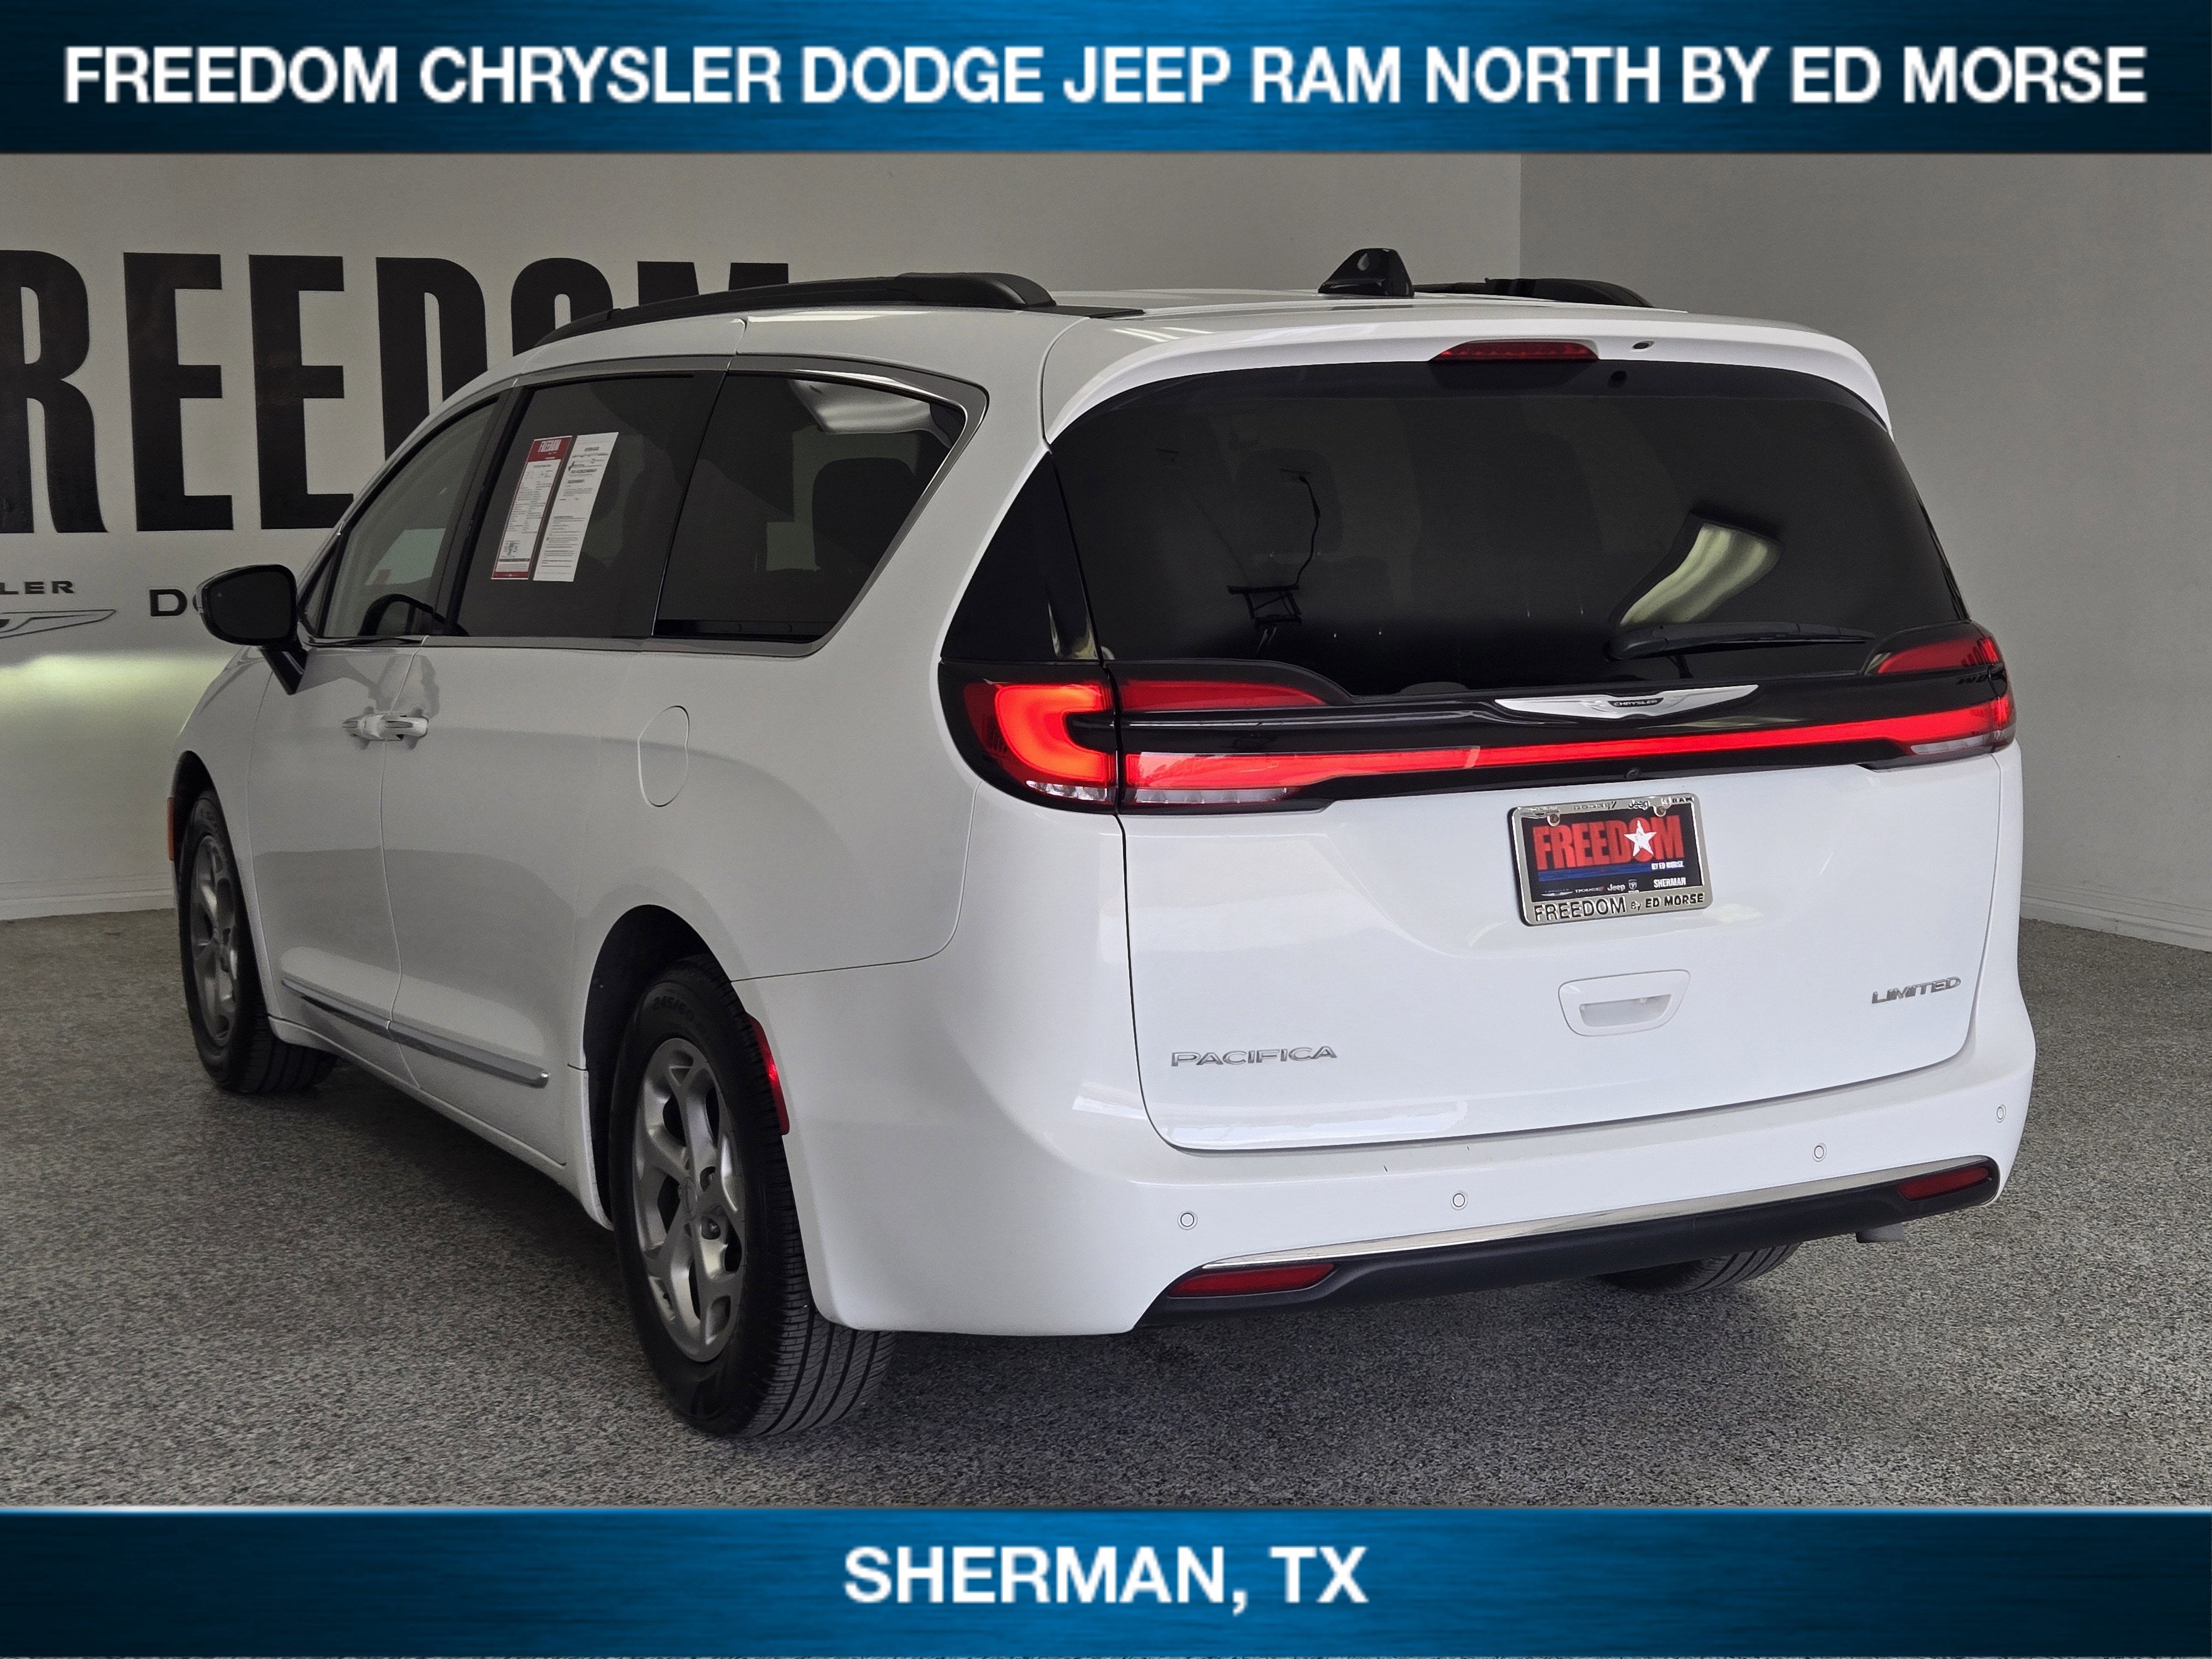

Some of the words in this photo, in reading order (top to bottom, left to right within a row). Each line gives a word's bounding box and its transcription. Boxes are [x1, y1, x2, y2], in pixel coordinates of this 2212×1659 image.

[0, 250, 789, 533] REED
[1532, 815, 1684, 870] FREEDOM
[1607, 883, 1625, 892] Jeep
[1653, 877, 1686, 888] SHERMAN
[1534, 896, 1626, 922] FREEDOM
[1645, 896, 1661, 908] ED
[1664, 892, 1704, 906] MORSE
[1871, 976, 1961, 1004] LIMITED
[1171, 1045, 1337, 1067] PACIFICA
